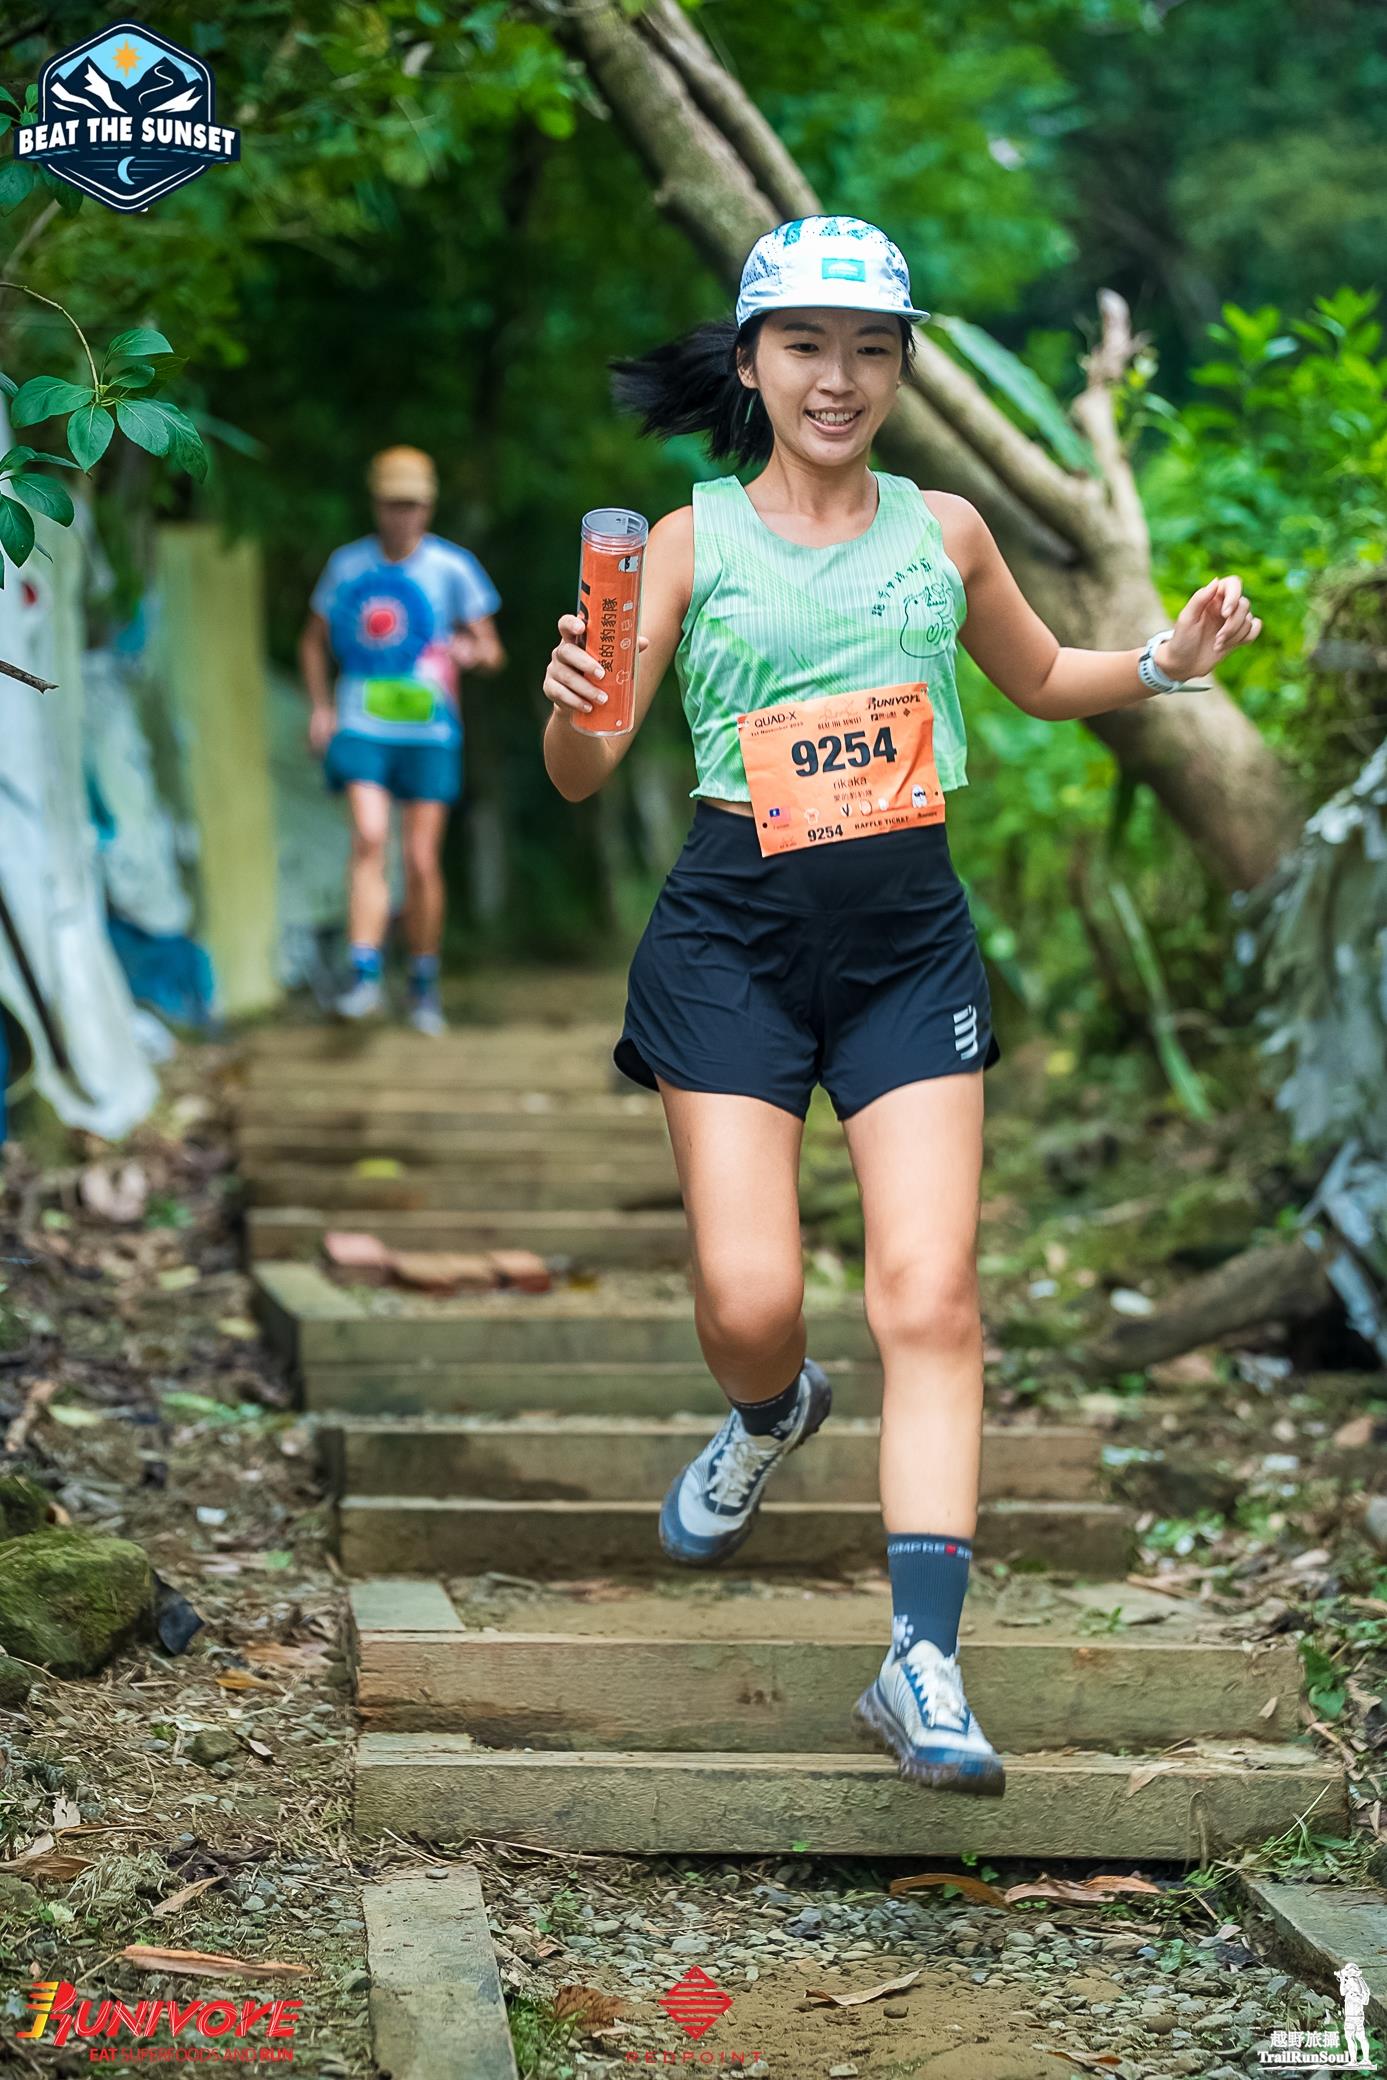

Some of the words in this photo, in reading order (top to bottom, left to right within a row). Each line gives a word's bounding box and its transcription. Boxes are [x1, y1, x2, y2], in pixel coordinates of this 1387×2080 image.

[754, 711, 797, 728] QUAD-X
[791, 726, 898, 778] 9254
[807, 824, 844, 842] 9254
